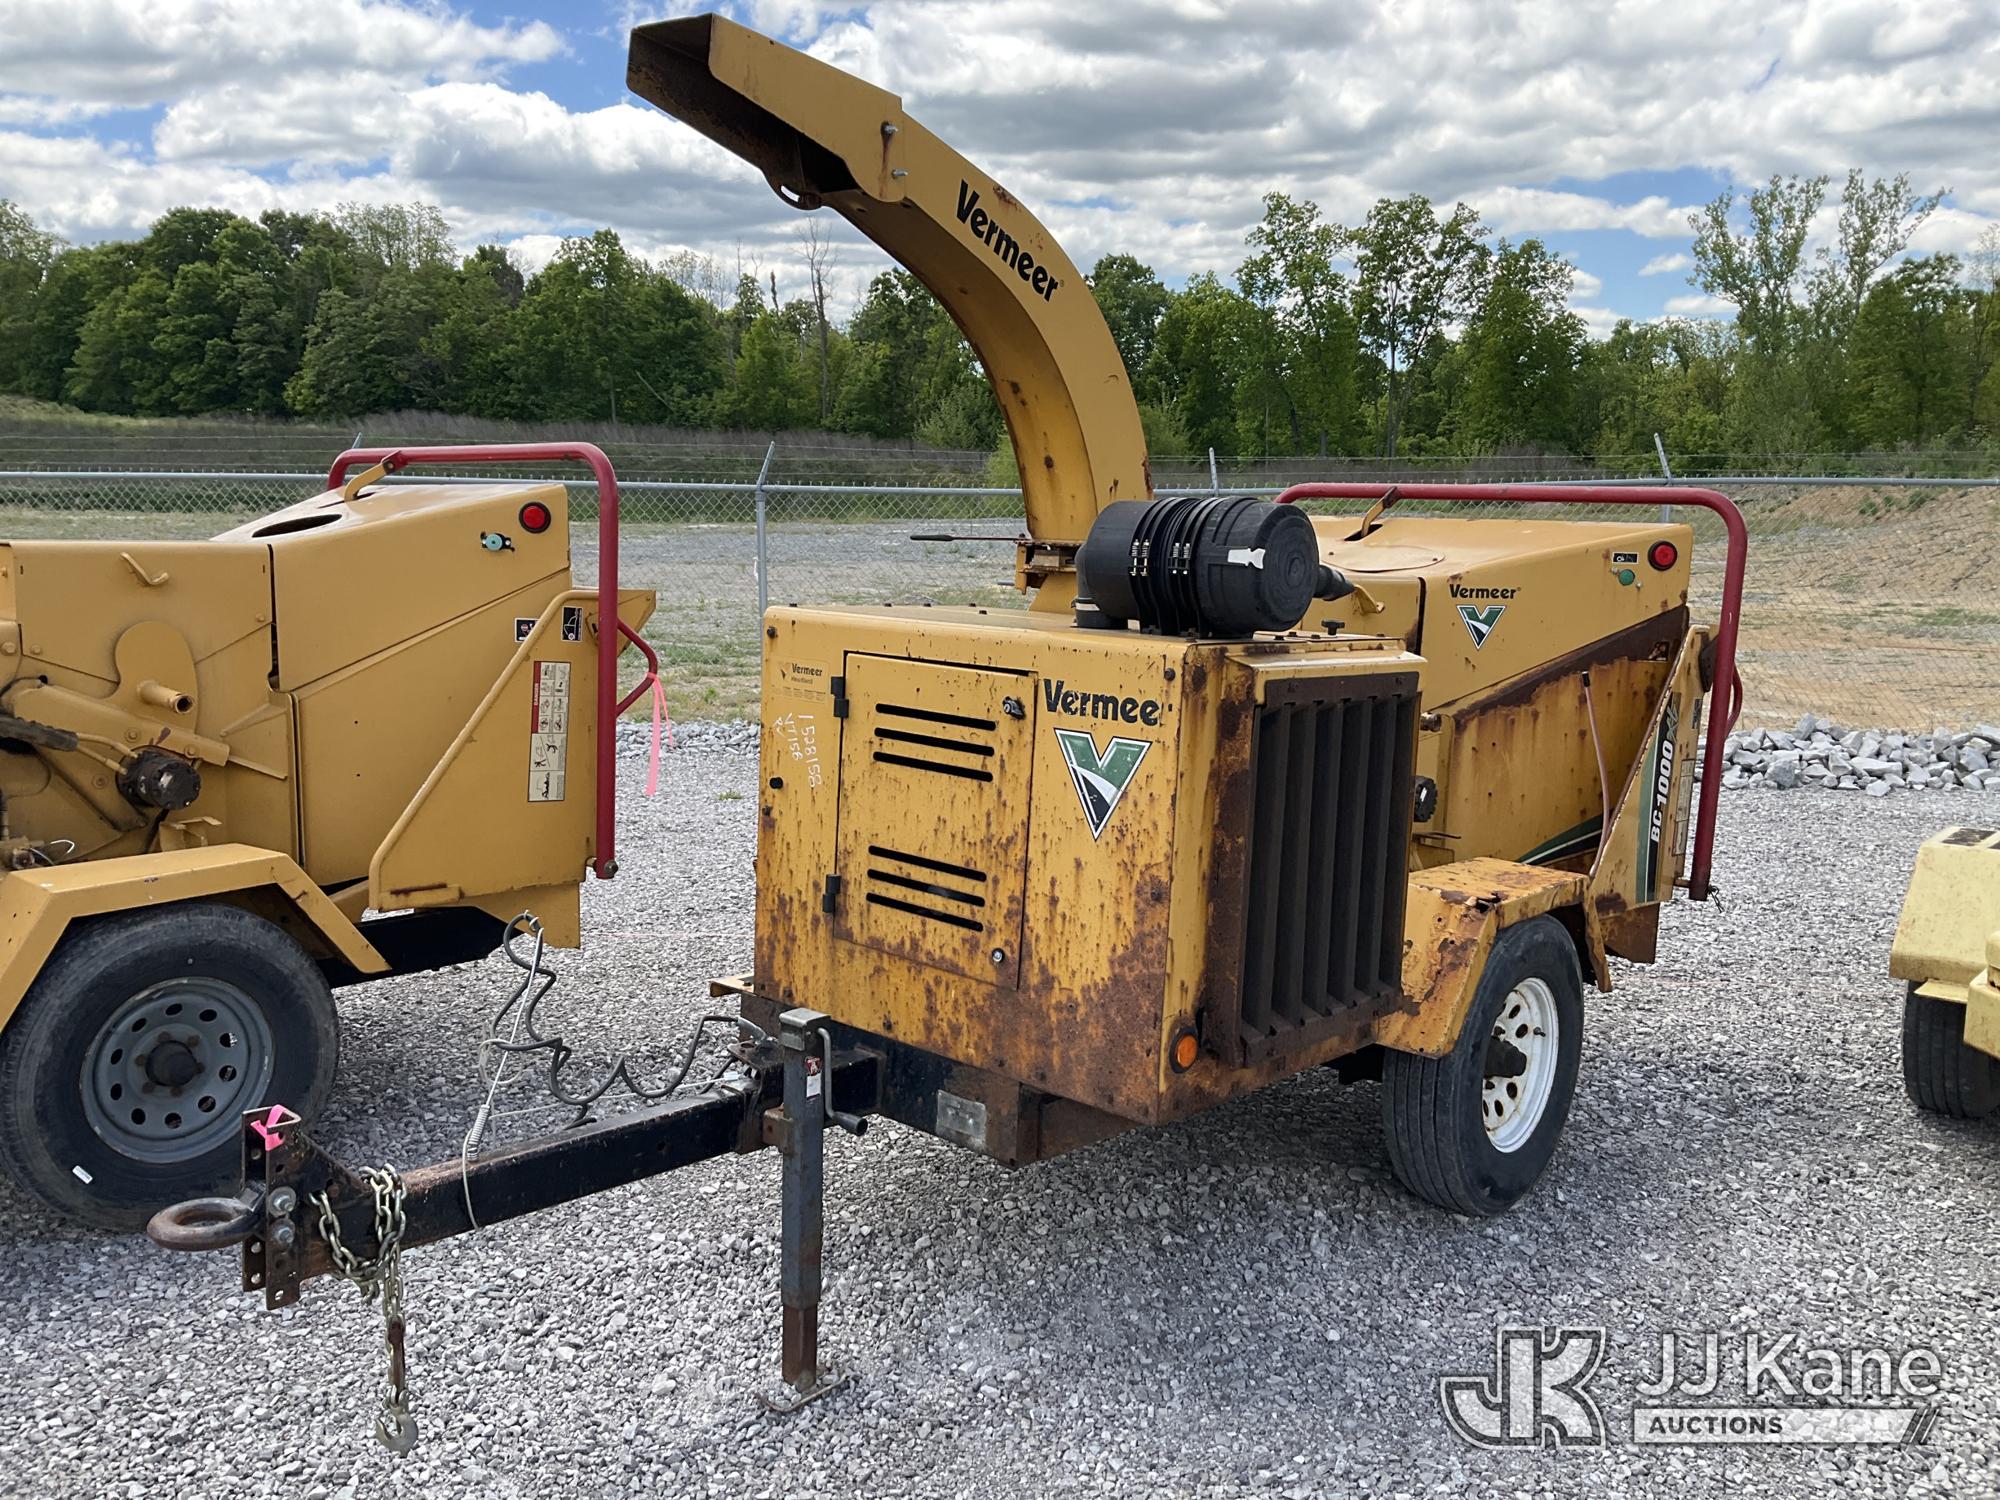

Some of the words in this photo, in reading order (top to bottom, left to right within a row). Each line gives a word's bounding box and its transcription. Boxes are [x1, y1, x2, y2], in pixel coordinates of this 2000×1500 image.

[957, 179, 1059, 302] Vermeer
[1449, 584, 1517, 599] Vermeer
[791, 662, 823, 677] Vermeer
[1043, 678, 1173, 726] Vermee
[1651, 809, 1663, 843] BC
[1657, 740, 1674, 806] 1000
